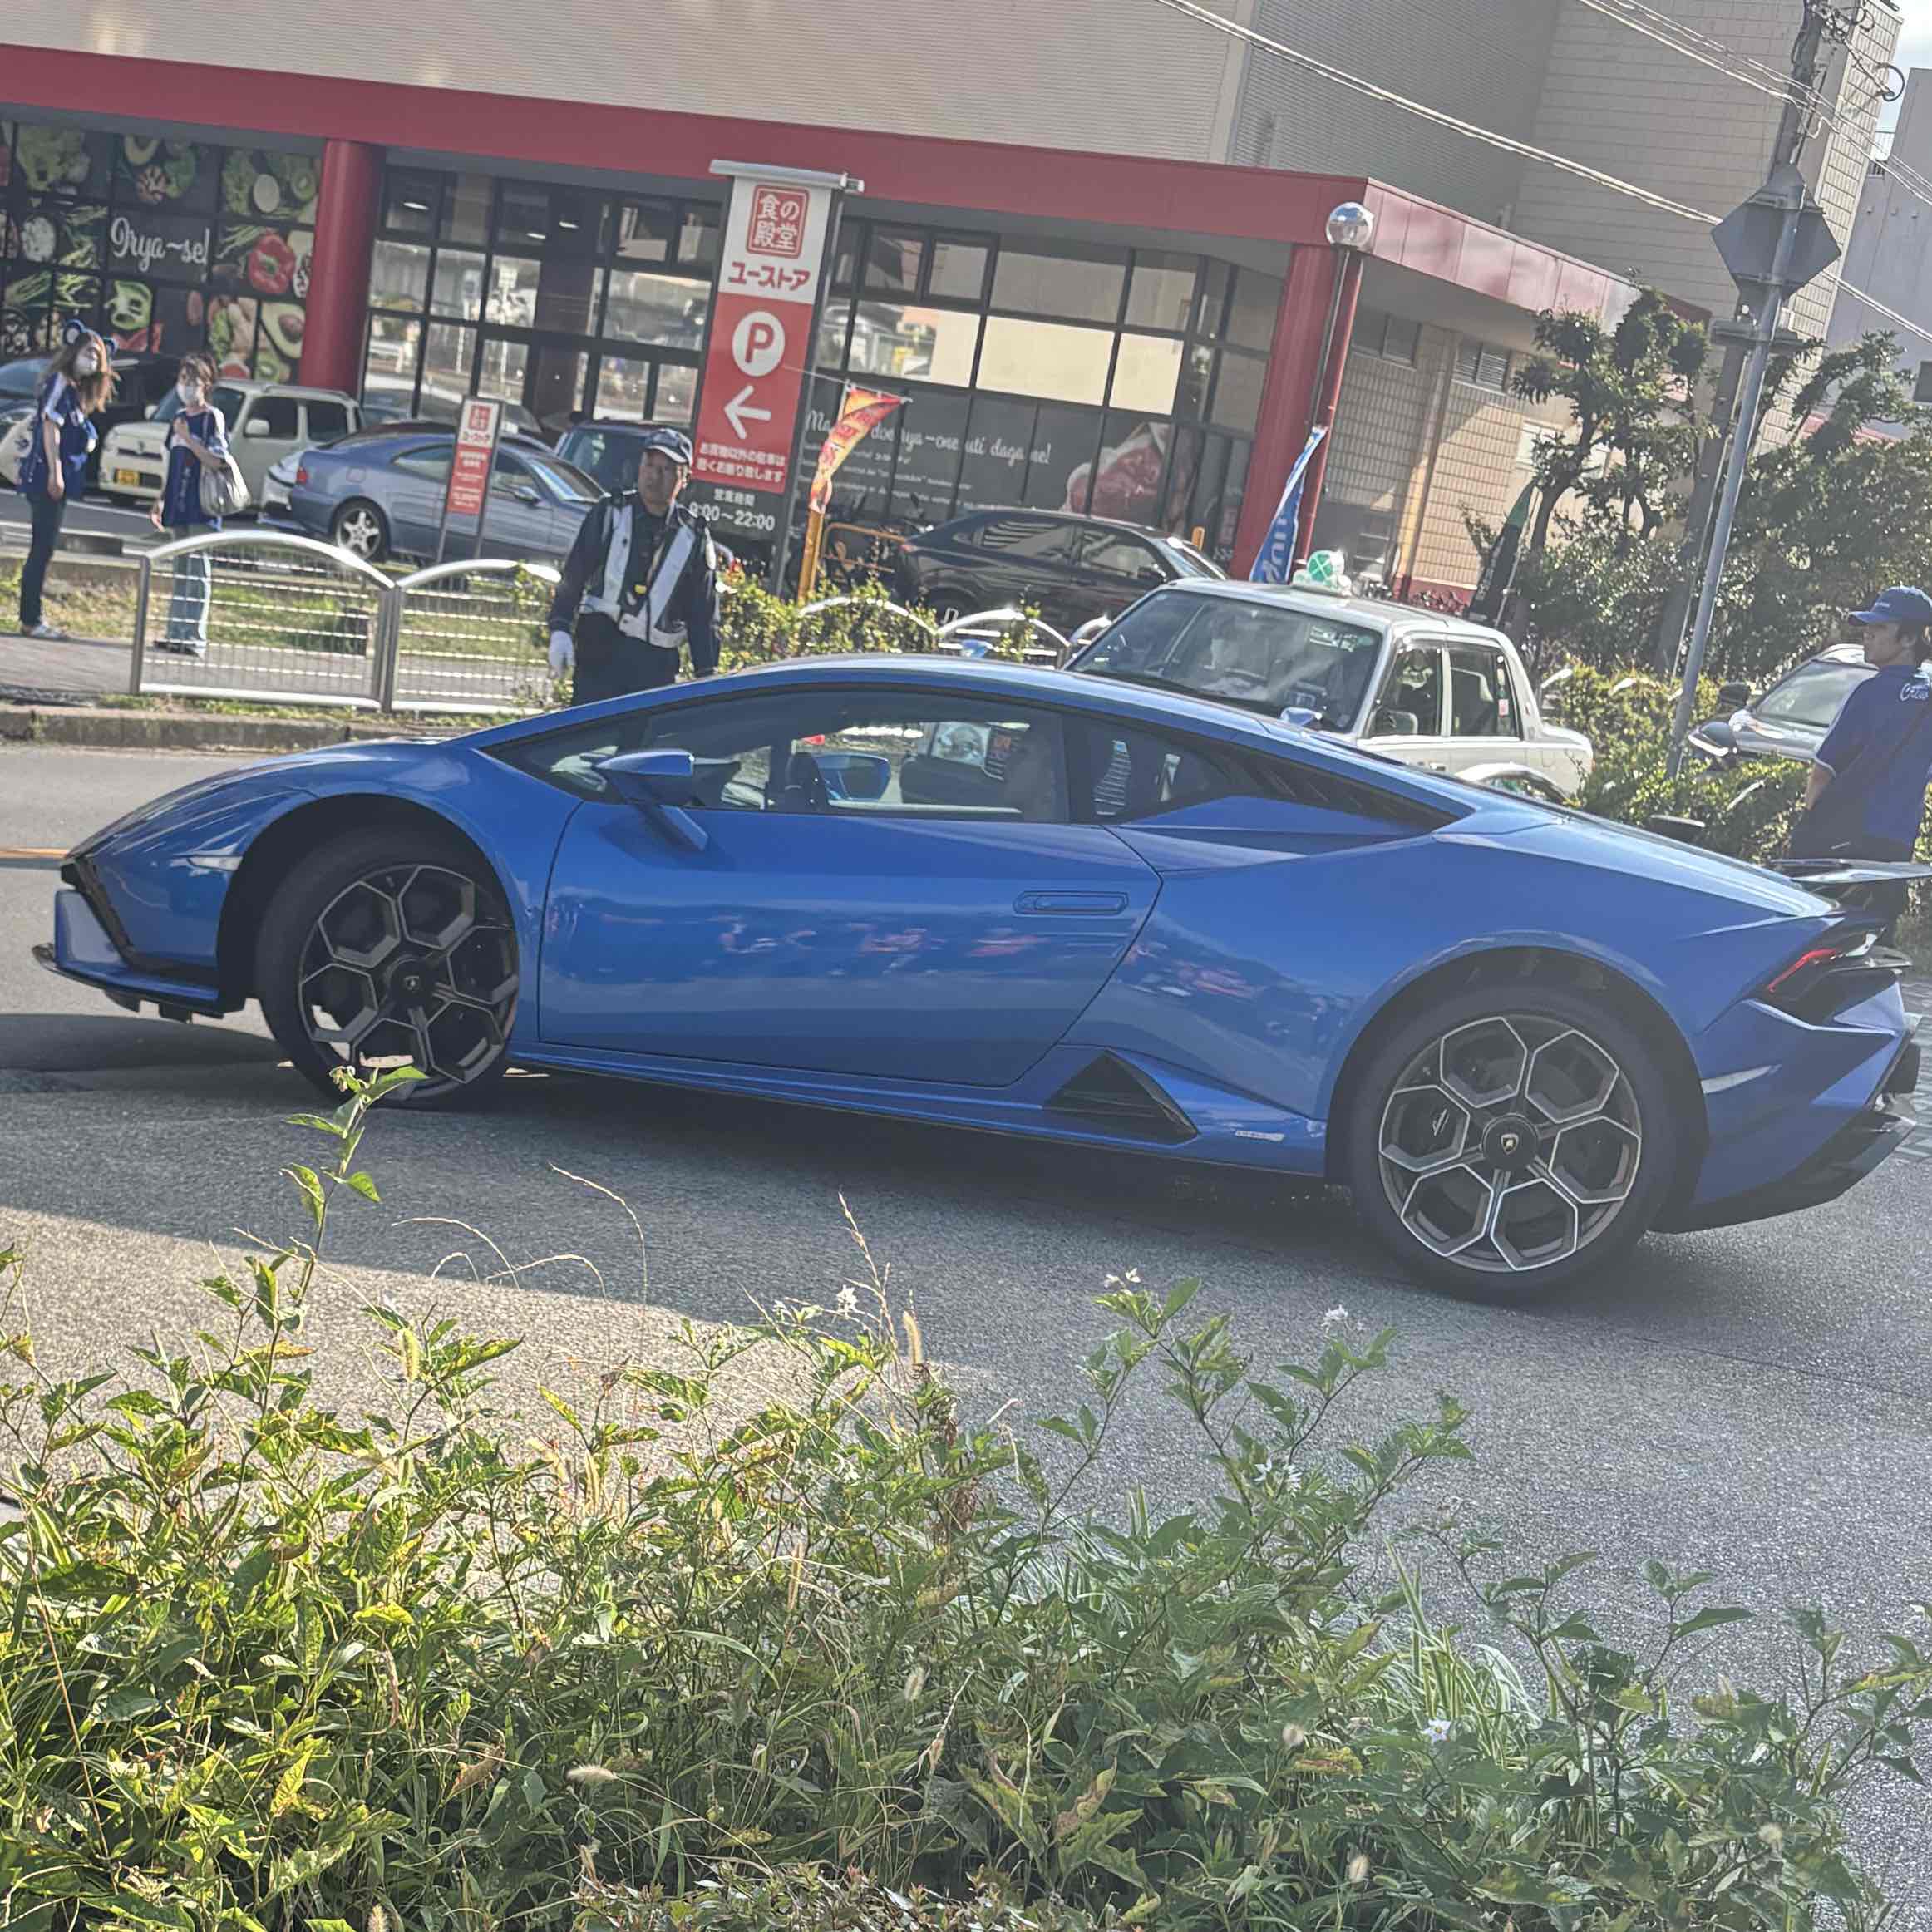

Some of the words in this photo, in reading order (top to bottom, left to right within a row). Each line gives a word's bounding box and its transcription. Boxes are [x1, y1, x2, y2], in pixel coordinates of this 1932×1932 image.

[728, 261, 810, 291] ユーストア
[745, 322, 774, 363] P
